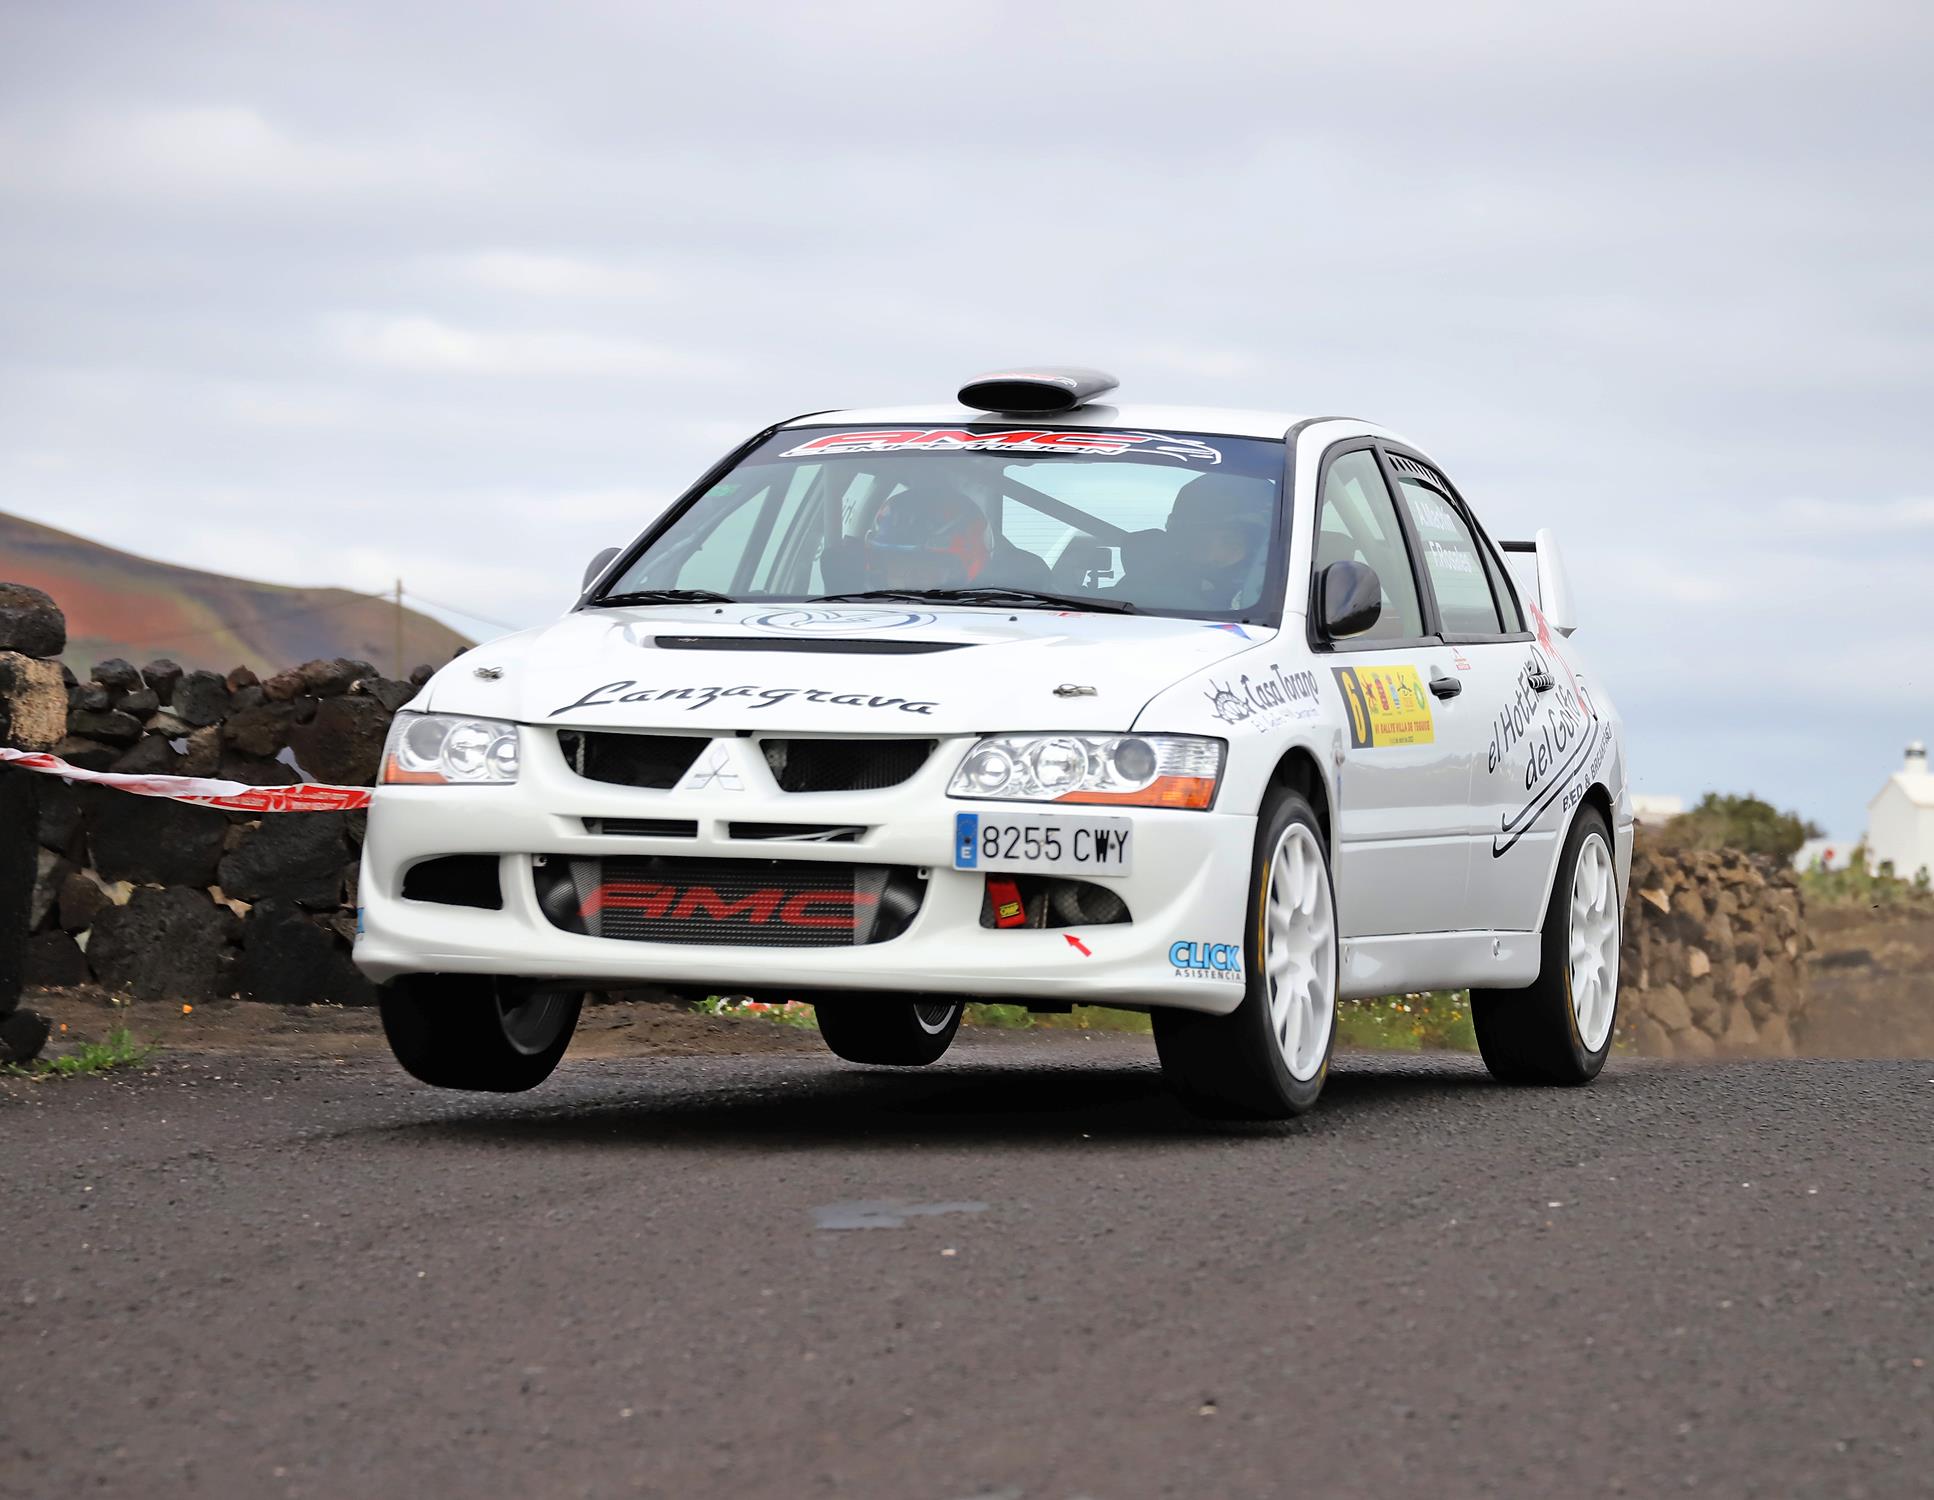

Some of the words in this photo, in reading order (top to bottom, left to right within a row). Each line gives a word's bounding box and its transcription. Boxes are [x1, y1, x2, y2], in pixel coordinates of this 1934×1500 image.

[797, 429, 1152, 451] AMC
[546, 680, 942, 718] Lanzagrava
[1240, 674, 1285, 710] Casa
[1341, 671, 1366, 744] 6
[1488, 721, 1501, 774] el
[1525, 724, 1553, 791] del
[1562, 783, 1583, 813] BED
[961, 847, 972, 859] E
[982, 825, 1062, 861] 8255
[1073, 828, 1129, 863] CWY
[577, 883, 875, 928] AMC
[1168, 940, 1241, 972] CLICK
[1175, 969, 1241, 980] ASISTENCIA
